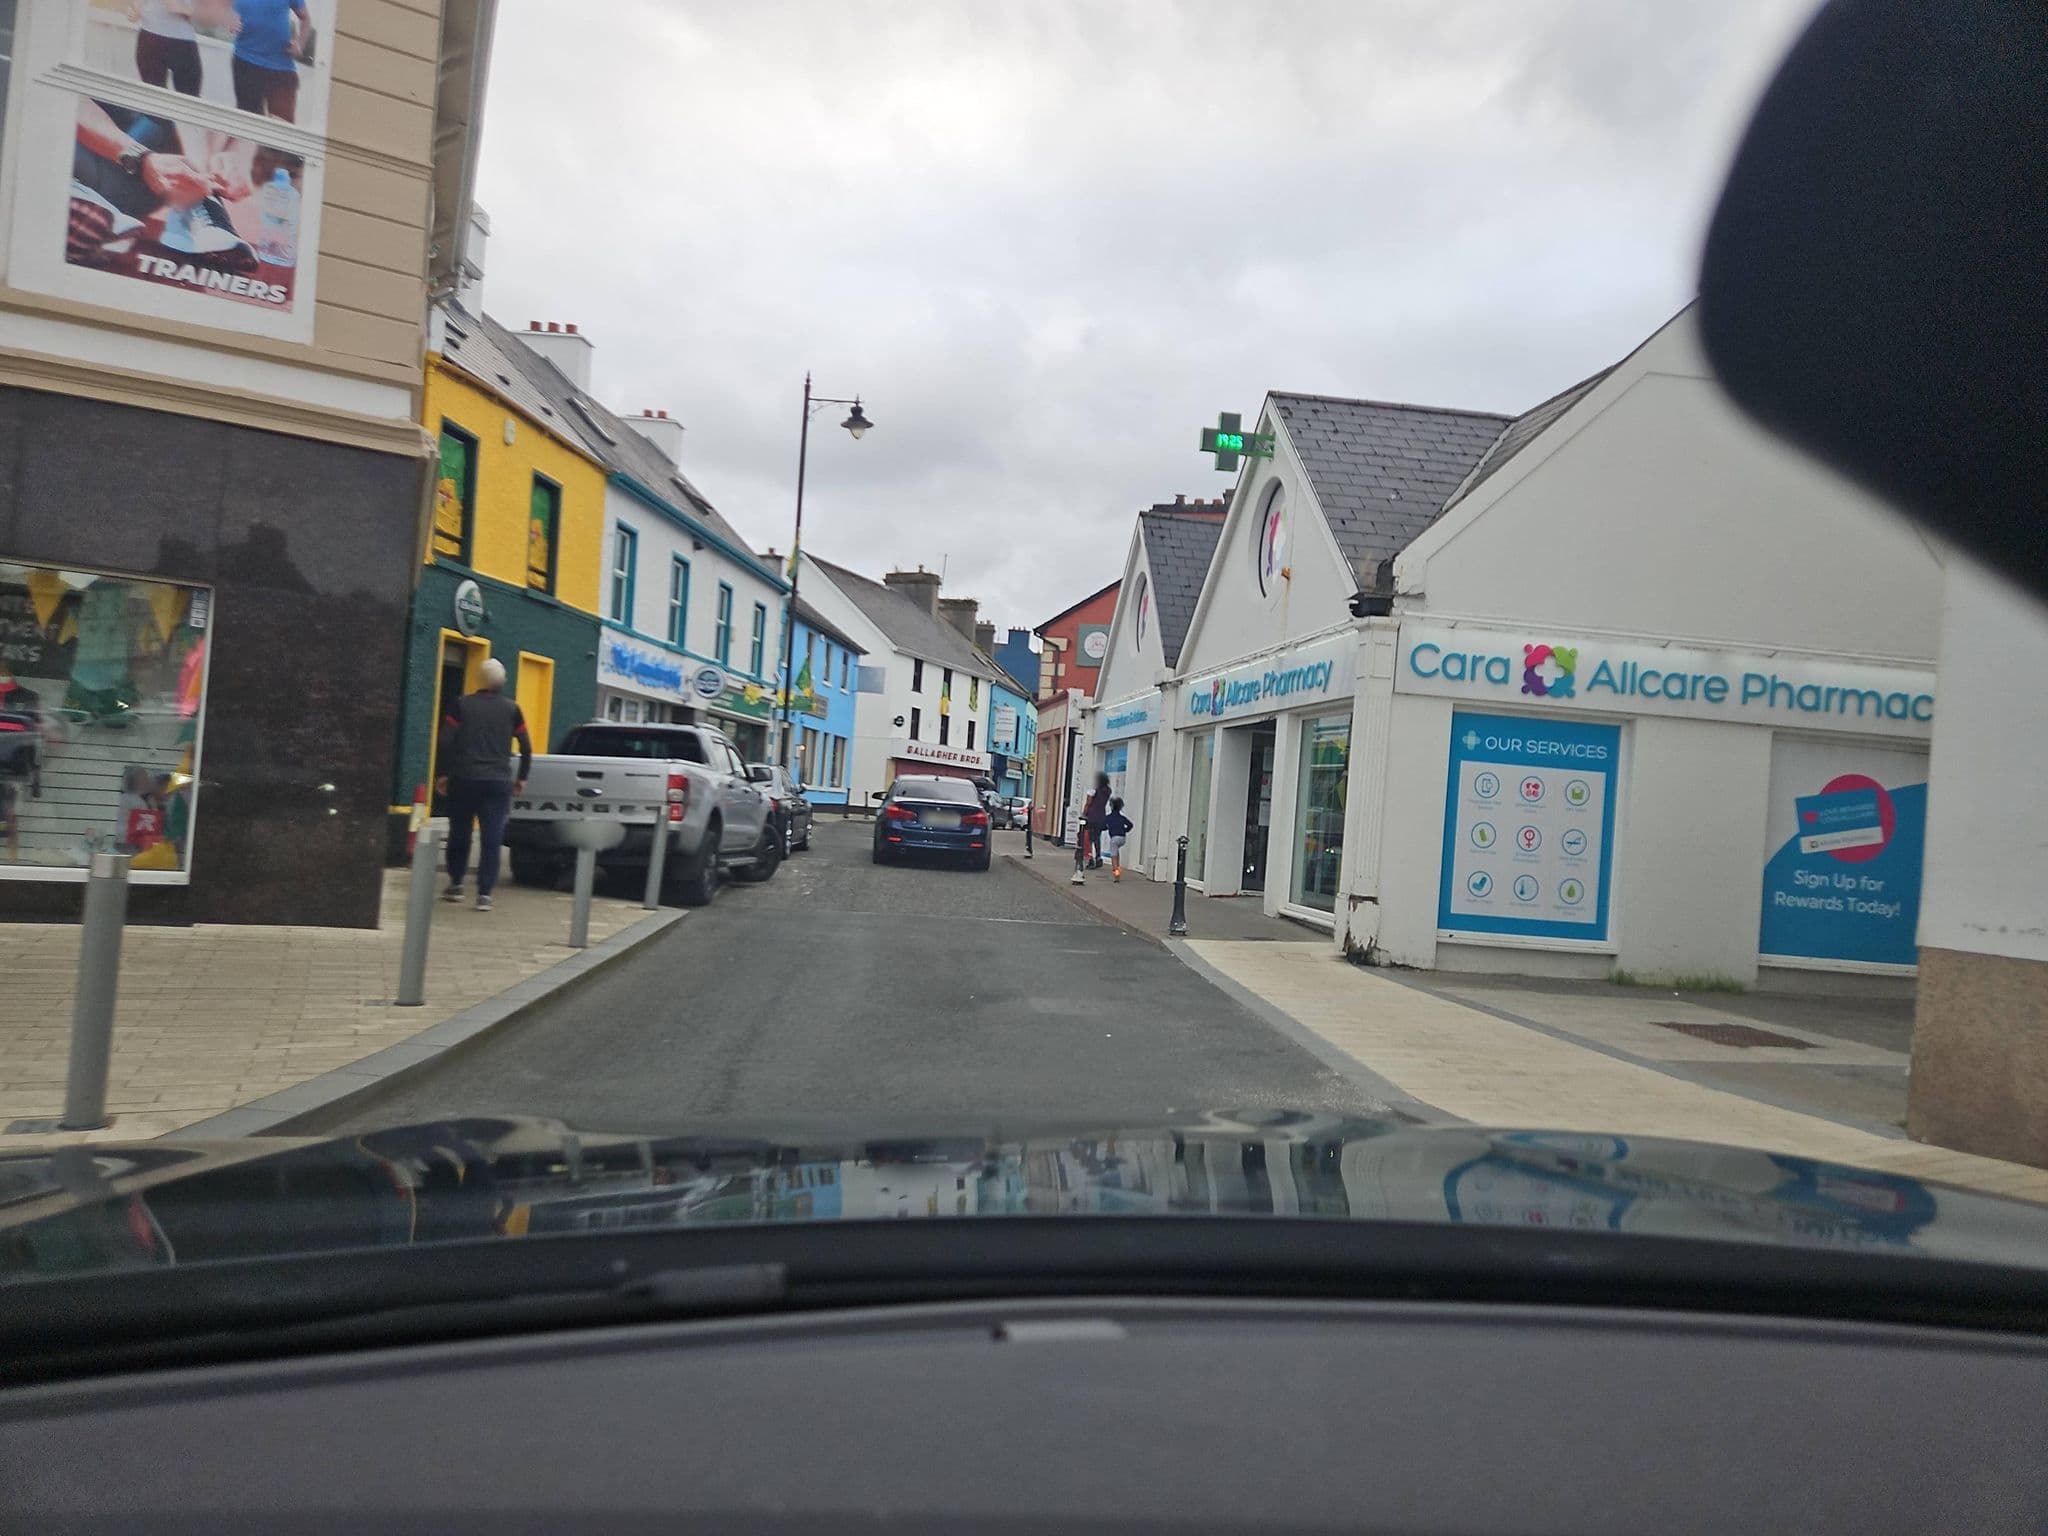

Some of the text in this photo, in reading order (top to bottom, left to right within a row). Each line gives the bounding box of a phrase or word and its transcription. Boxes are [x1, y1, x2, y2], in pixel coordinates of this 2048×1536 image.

[137, 255, 287, 304] TRAINERS
[1225, 678, 1262, 707] Allcare
[1262, 659, 1334, 699] Pharmacy
[1410, 642, 1935, 723] Cara Allcare Pharmac
[907, 746, 958, 760] GALLAGHER
[1485, 736, 1608, 759] OUR SERVICES
[1793, 870, 1885, 891] Sign Up for
[1775, 891, 1901, 918] Rewards Today!
